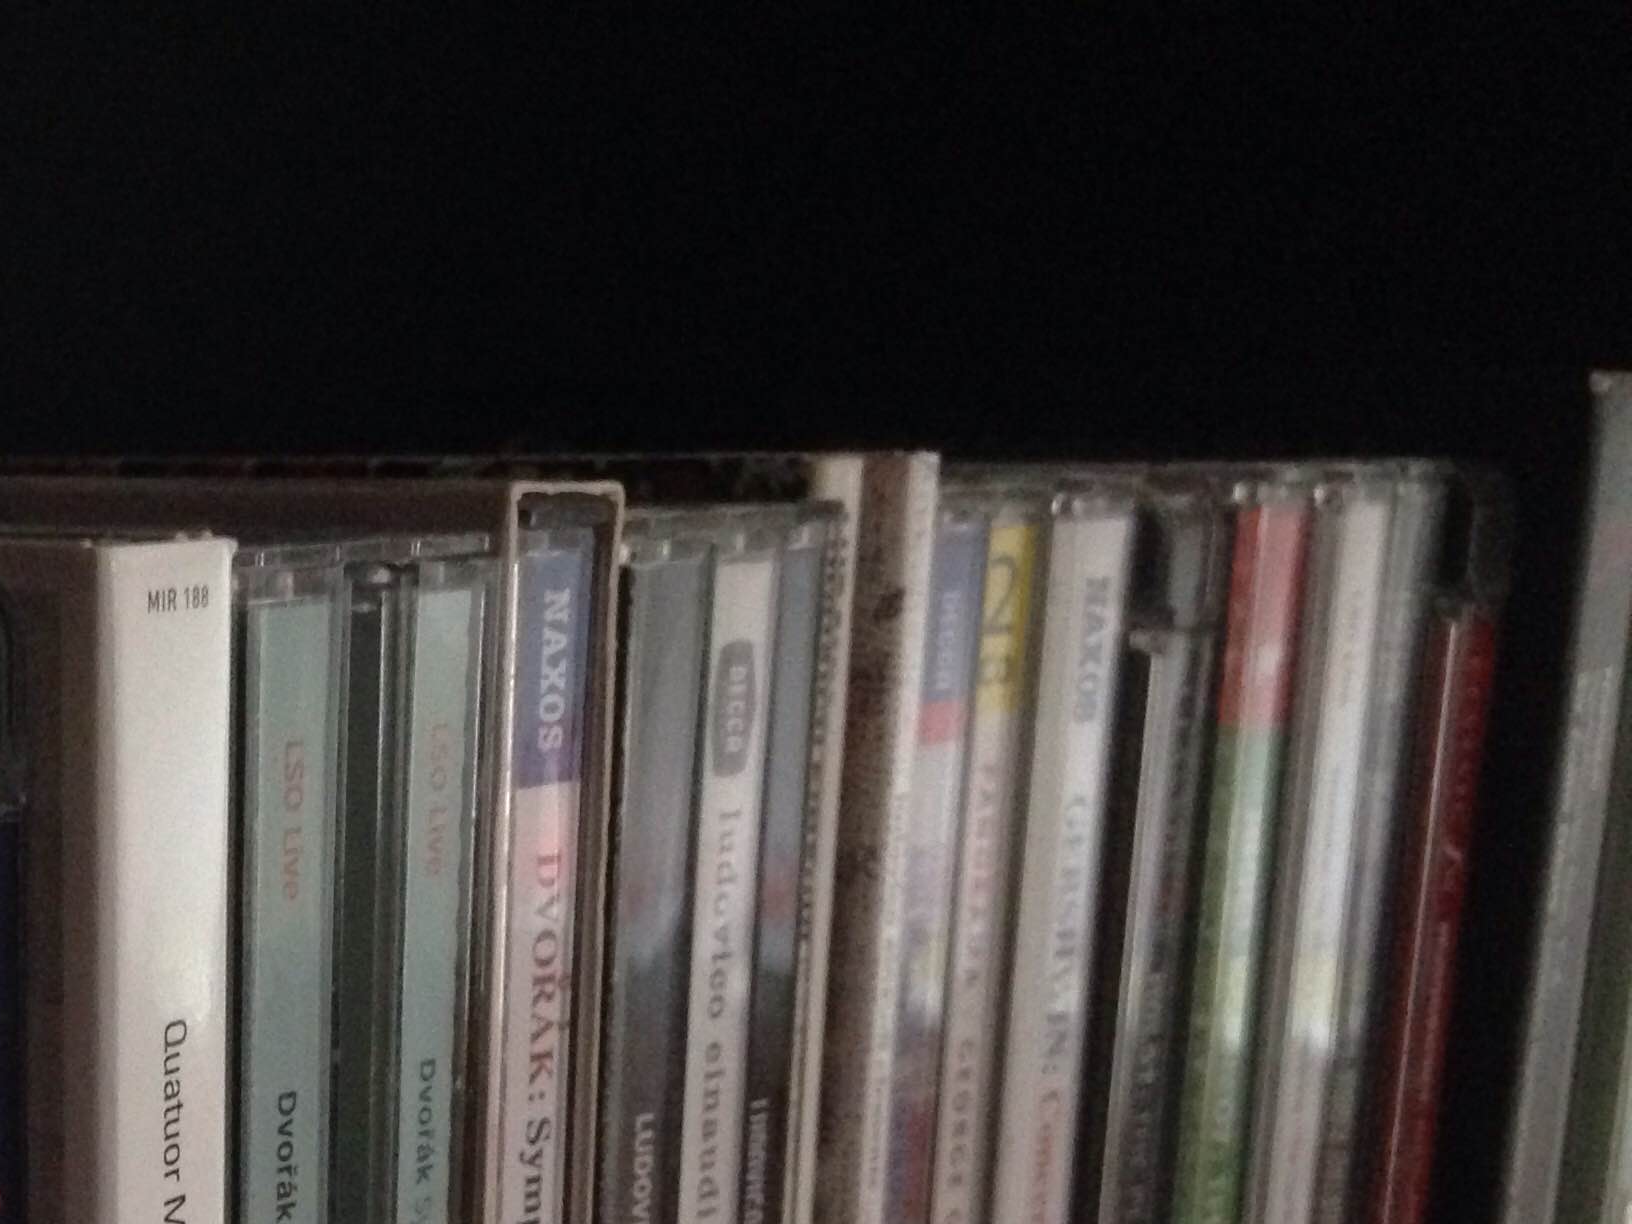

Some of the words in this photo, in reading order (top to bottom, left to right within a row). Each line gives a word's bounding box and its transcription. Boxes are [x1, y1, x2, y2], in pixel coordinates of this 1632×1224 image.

[147, 588, 178, 614] MIR
[184, 585, 209, 609] 188
[537, 587, 571, 751] NAXOS
[284, 740, 305, 813] LSO
[282, 826, 304, 902] Live
[706, 809, 743, 1020] ludovico
[528, 847, 571, 1103] DVOŘÁK:
[162, 1019, 188, 1182] Quatuor
[275, 1091, 297, 1220] Dvořák
[695, 1041, 728, 1220] einaudi
